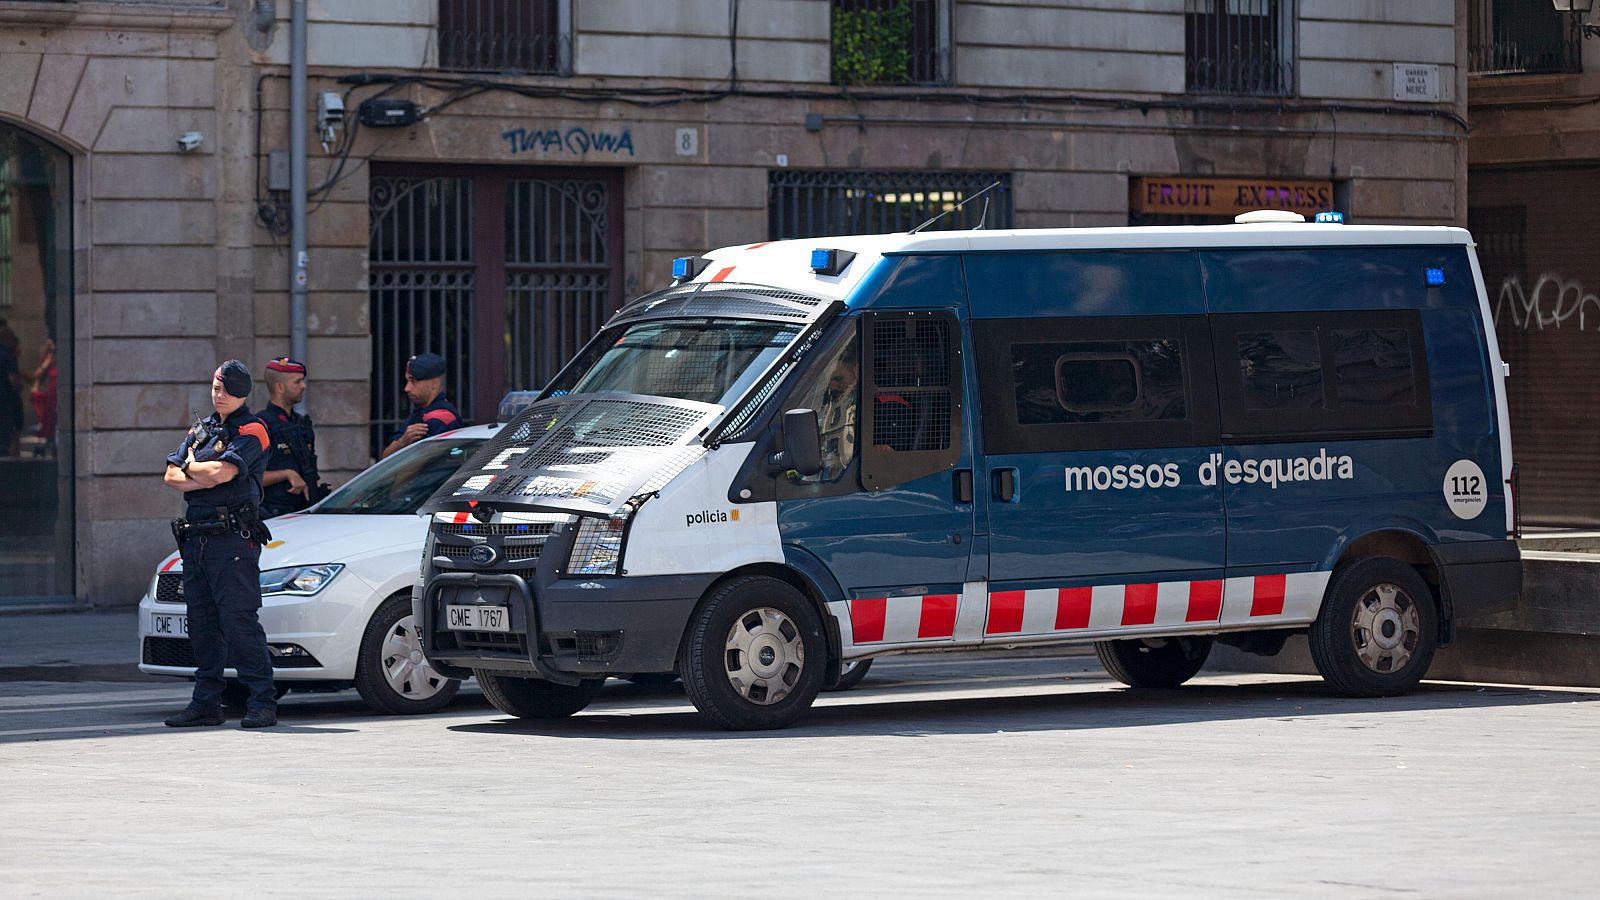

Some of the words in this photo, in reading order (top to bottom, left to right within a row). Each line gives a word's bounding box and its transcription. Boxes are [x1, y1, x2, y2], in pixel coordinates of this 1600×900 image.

[681, 133, 692, 151] 8
[1147, 183, 1216, 207] FRUIT
[1064, 462, 1181, 492] mossos
[1198, 447, 1354, 490] d'esquadra
[1451, 475, 1481, 496] 112
[686, 509, 728, 527] policia
[156, 616, 172, 634] CME
[450, 608, 472, 627] CME
[479, 609, 503, 628] 1767
